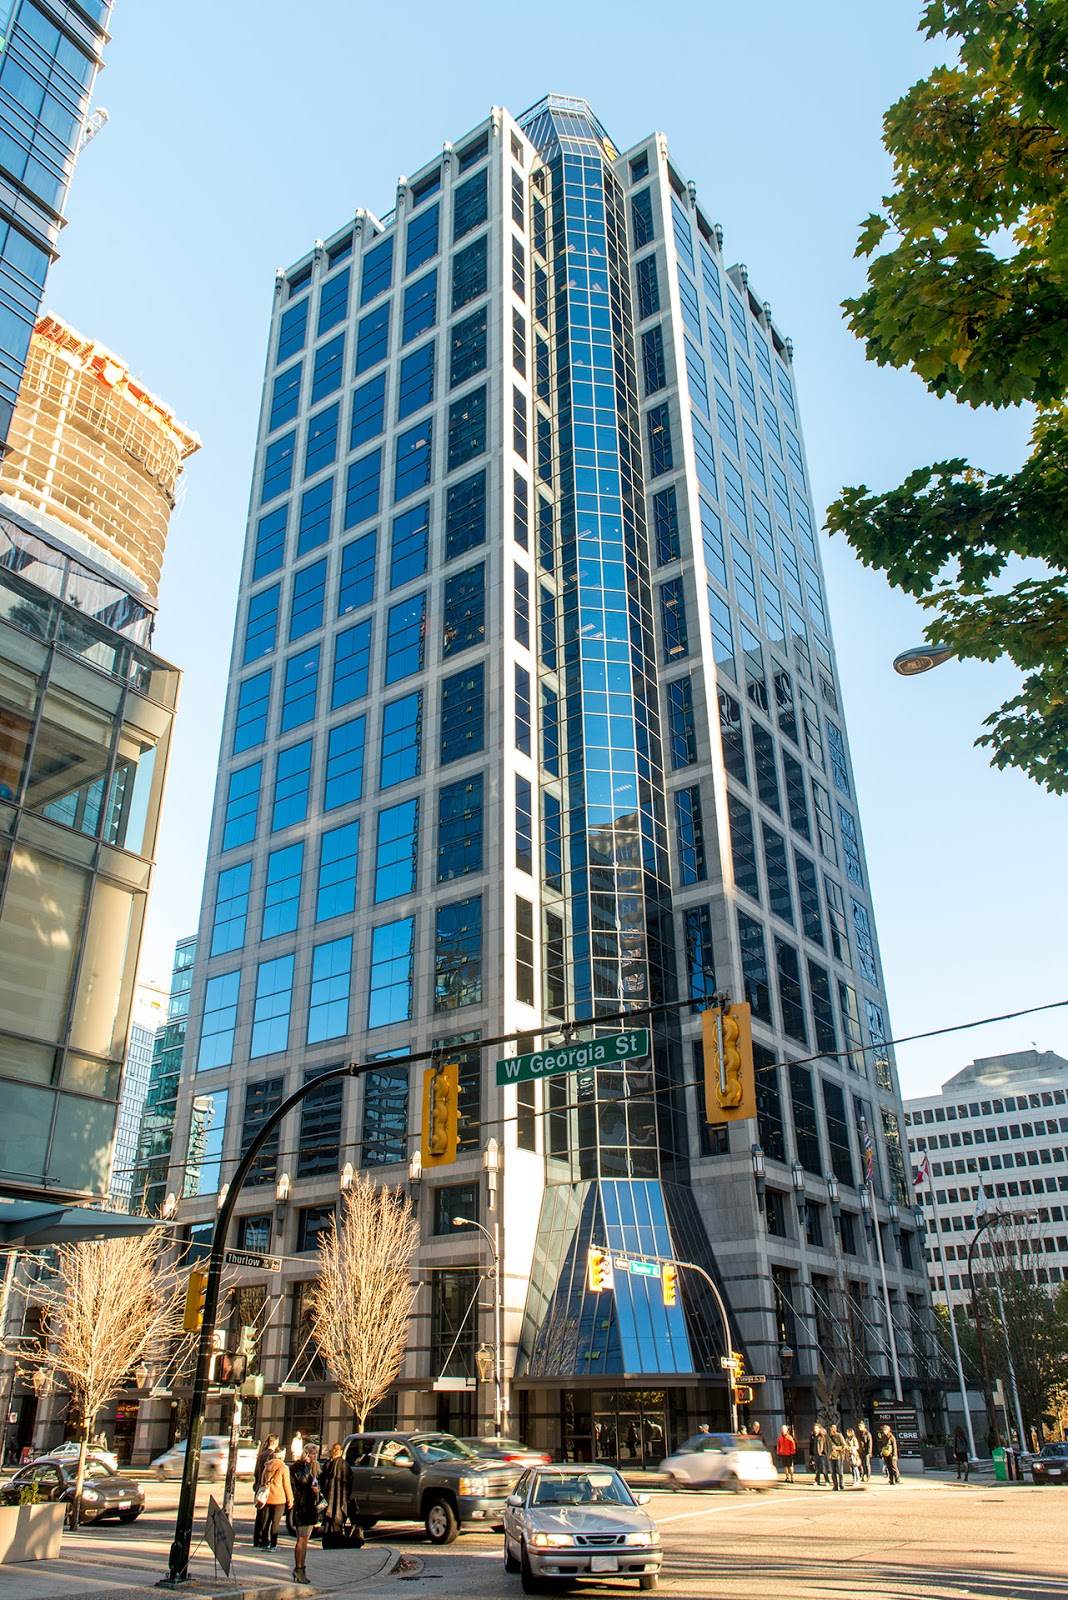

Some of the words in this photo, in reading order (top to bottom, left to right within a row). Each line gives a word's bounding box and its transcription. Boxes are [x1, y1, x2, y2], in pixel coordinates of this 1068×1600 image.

[504, 1059, 522, 1079] W
[530, 1043, 605, 1073] Georgia
[615, 1034, 638, 1055] St
[228, 1253, 261, 1267] Thurlow
